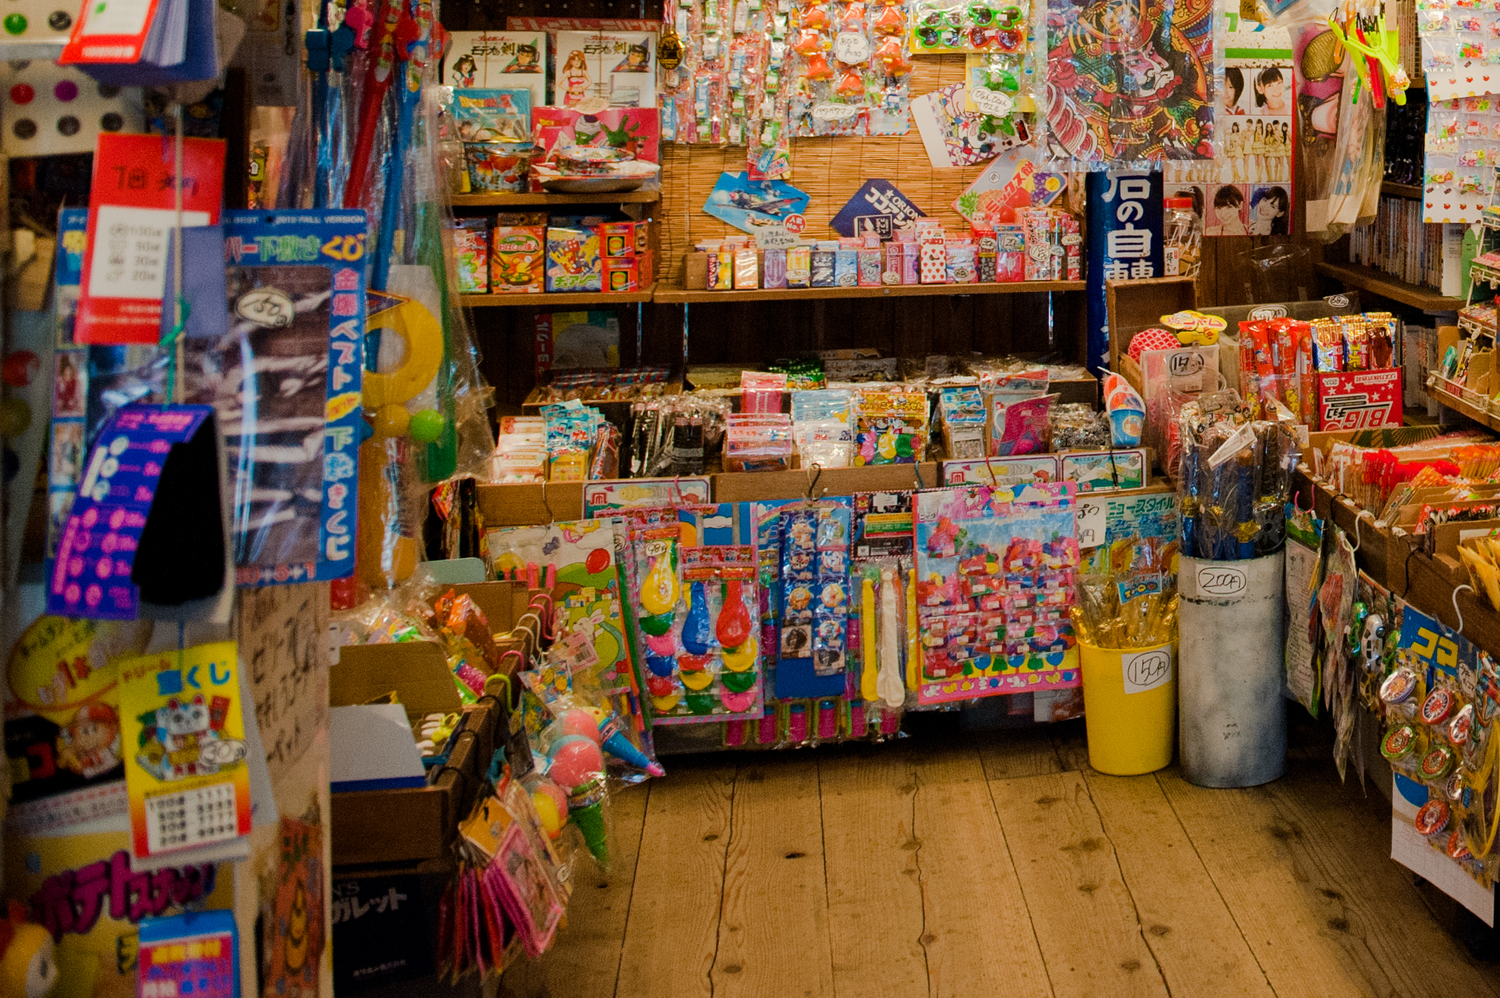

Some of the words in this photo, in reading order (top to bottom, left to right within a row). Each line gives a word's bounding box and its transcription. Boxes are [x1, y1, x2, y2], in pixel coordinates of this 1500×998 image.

[892, 196, 921, 218] ORION
[1342, 409, 1387, 436] BIG
[1108, 497, 1175, 515] ニュースタイル
[1411, 626, 1459, 668] コマ
